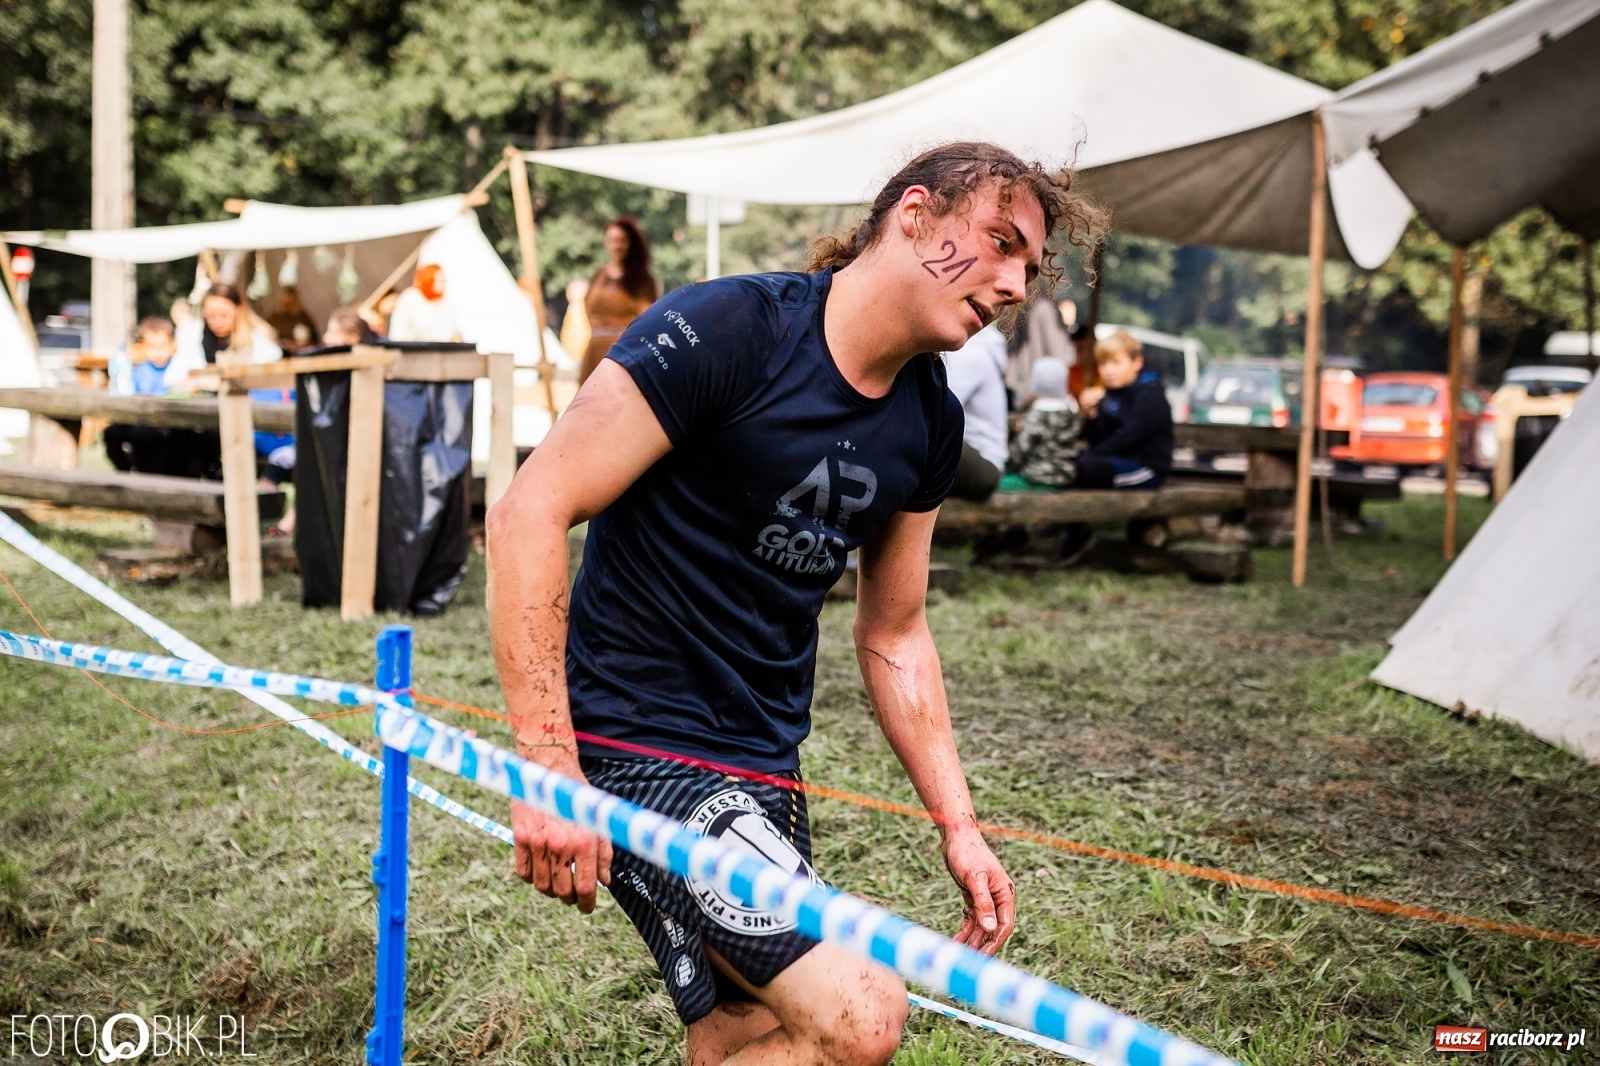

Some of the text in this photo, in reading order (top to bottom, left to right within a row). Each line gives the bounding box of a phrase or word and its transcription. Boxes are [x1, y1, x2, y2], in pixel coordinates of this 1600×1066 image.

[920, 240, 979, 285] 21
[697, 794, 738, 824] WEST
[699, 890, 726, 916] PIT
